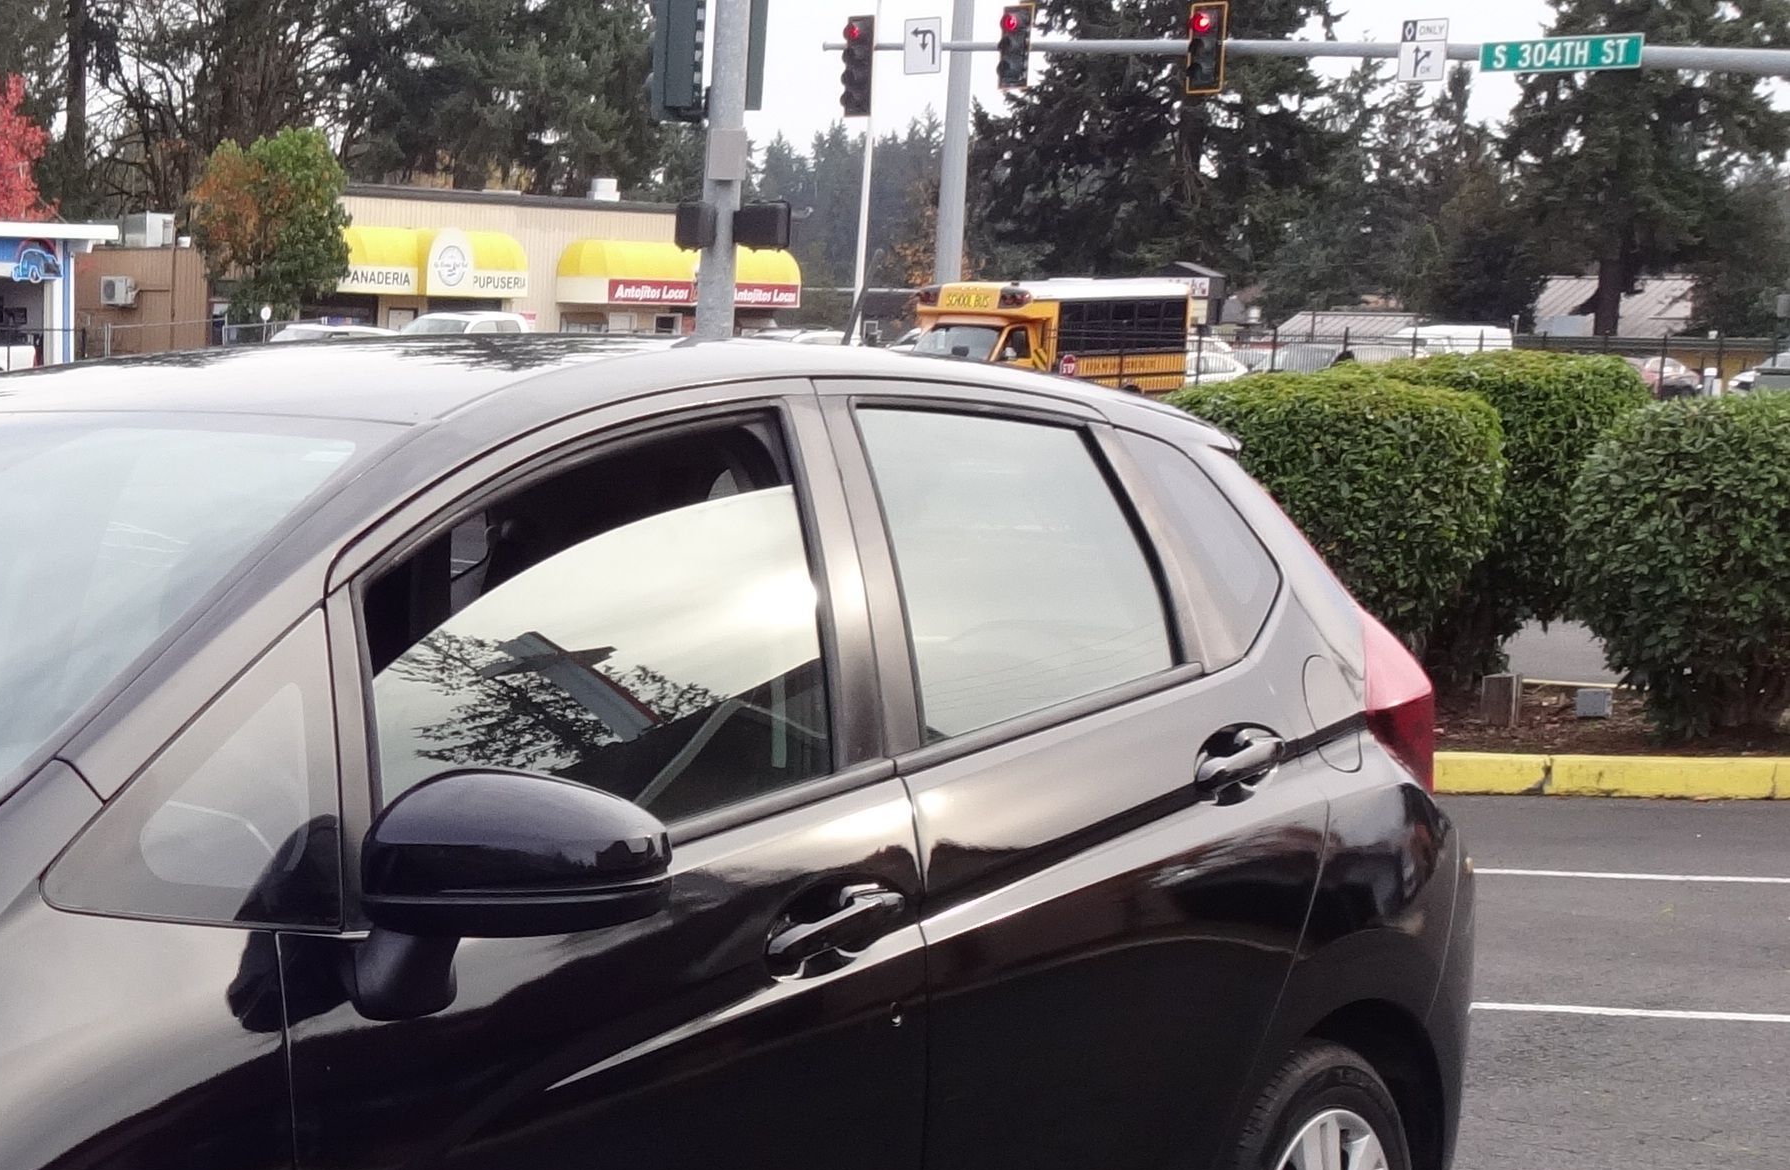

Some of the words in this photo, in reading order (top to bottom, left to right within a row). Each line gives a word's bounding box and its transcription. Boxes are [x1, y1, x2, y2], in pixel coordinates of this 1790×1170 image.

[1418, 24, 1445, 36] ONLY
[1493, 45, 1507, 69] S
[1517, 41, 1589, 67] 304TH
[1601, 38, 1629, 64] ST
[1420, 65, 1431, 74] OK
[615, 284, 661, 301] Antojitos
[662, 286, 689, 300] Locos
[946, 293, 973, 307] SCHOOL
[974, 294, 989, 307] BUS
